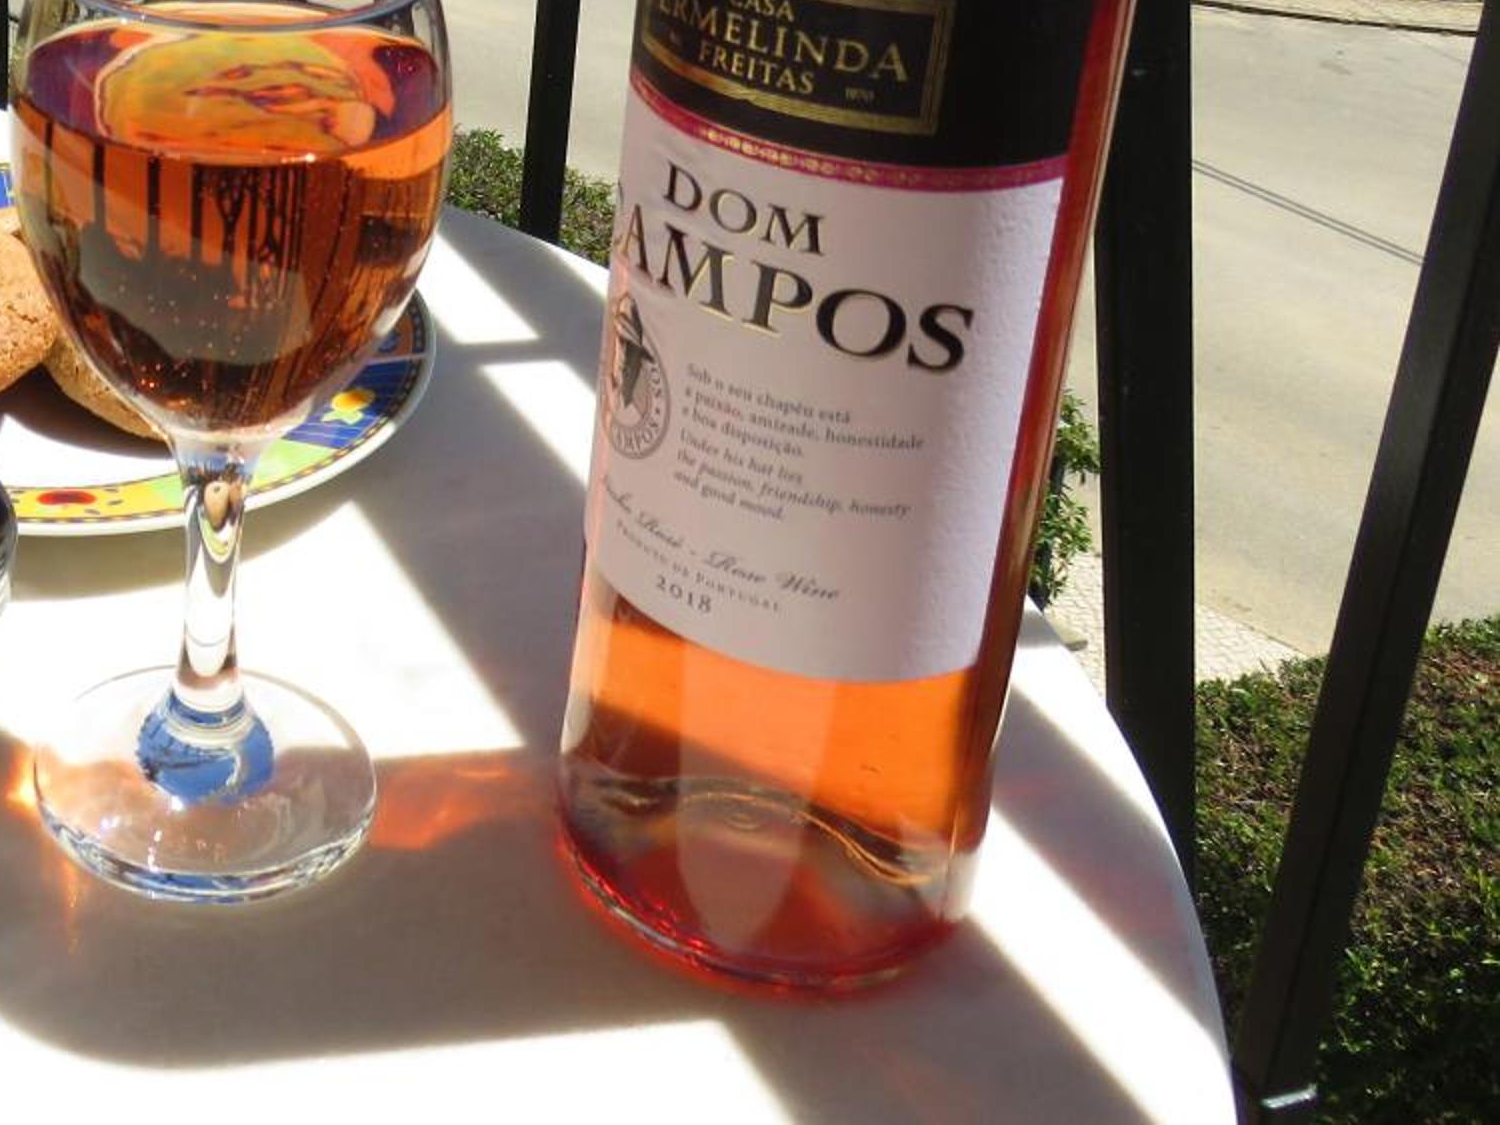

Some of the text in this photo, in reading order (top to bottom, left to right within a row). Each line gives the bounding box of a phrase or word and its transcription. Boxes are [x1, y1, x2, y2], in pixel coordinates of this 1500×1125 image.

[699, 40, 815, 94] FREITAS
[663, 161, 826, 256] DOM
[614, 179, 974, 372] AMPOS
[655, 575, 712, 614] 2018
